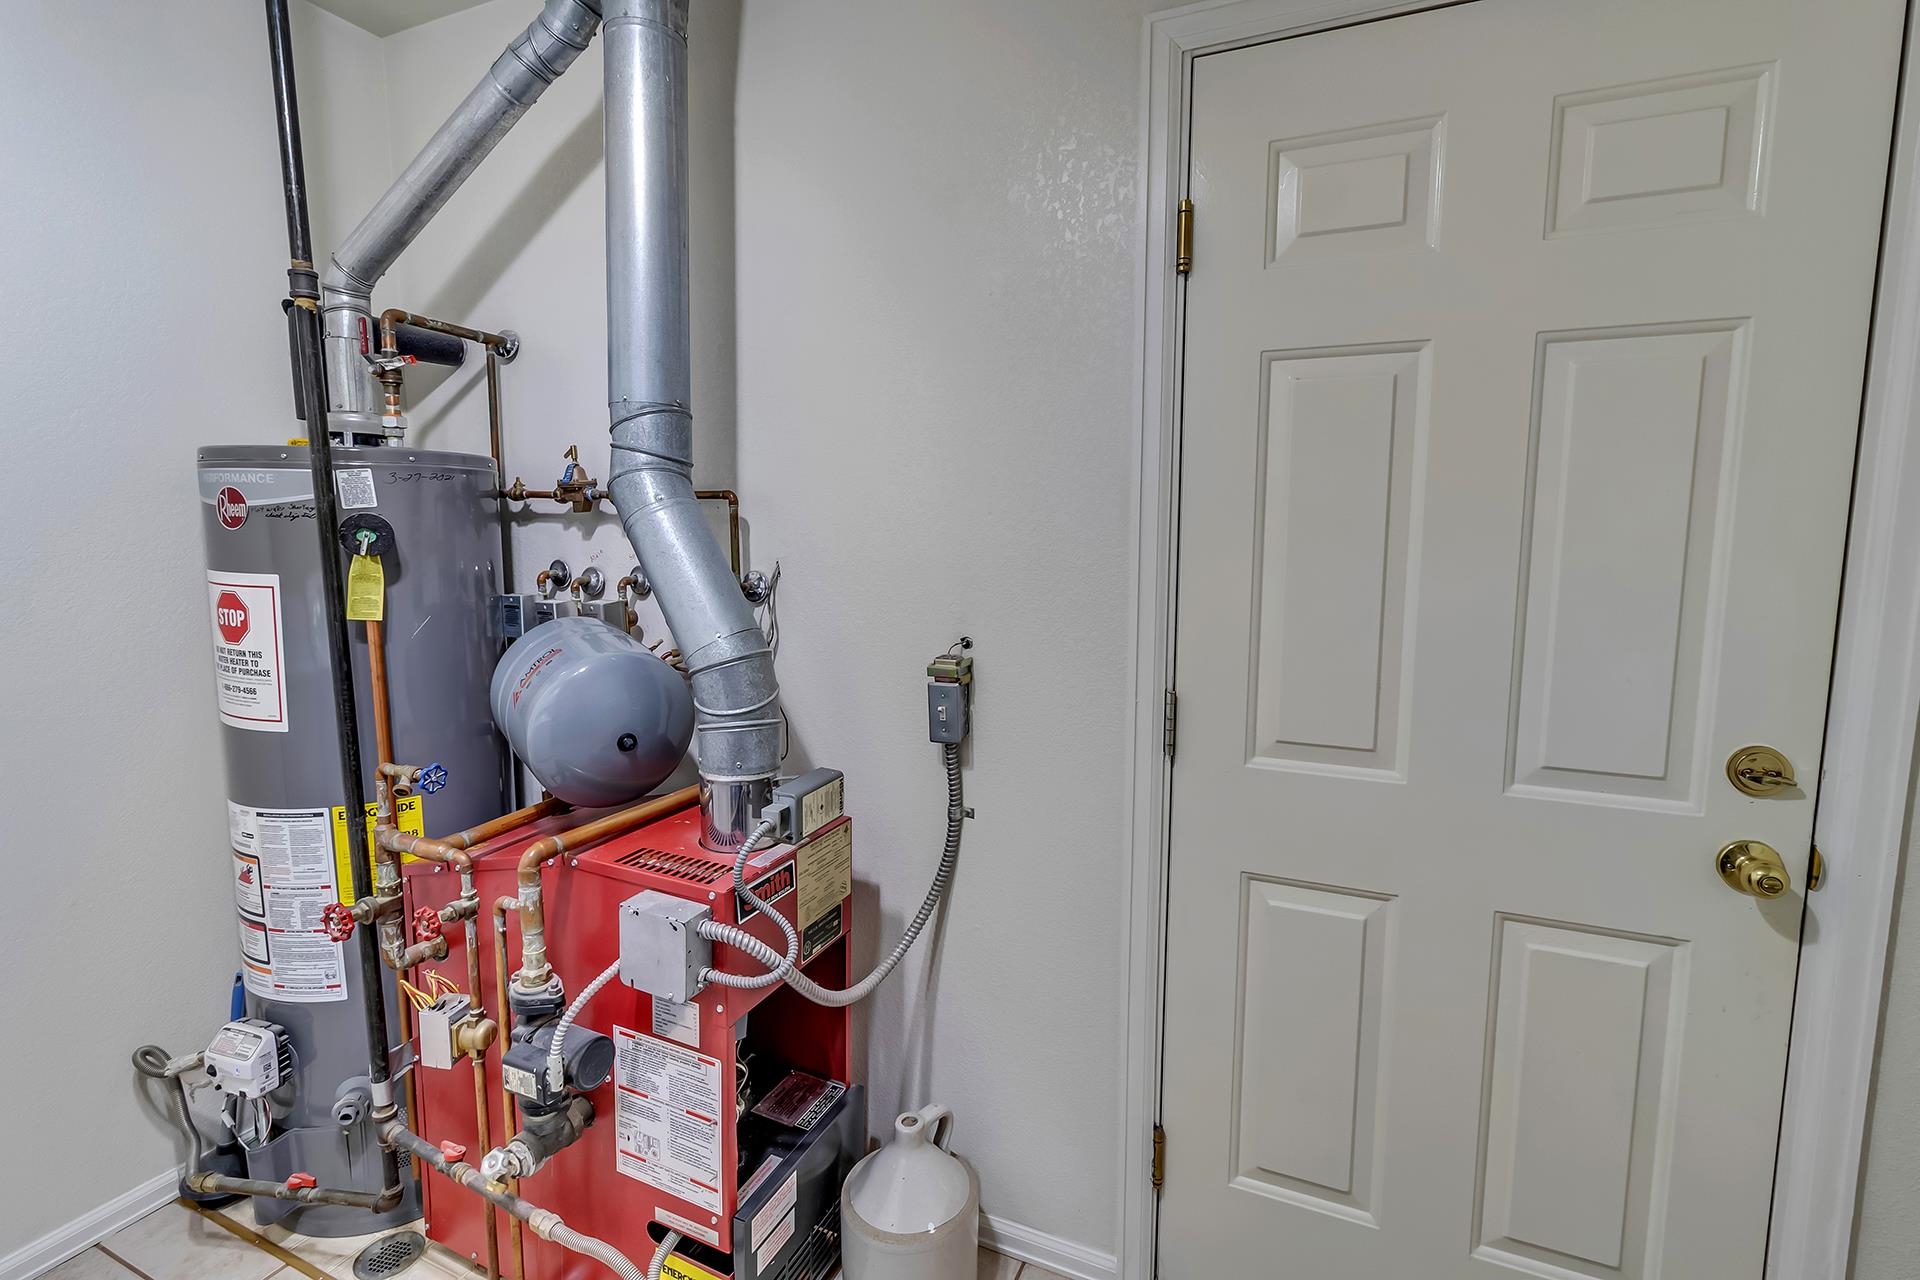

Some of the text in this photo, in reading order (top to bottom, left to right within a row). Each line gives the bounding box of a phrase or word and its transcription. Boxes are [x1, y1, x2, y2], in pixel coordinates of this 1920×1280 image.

[219, 486, 246, 523] Rheem
[218, 607, 245, 627] STOP
[227, 648, 246, 657] RETURN
[248, 650, 262, 659] THIS
[230, 658, 248, 667] HEATER
[520, 648, 555, 685] AMTROL
[239, 668, 271, 677] PURCHASE
[662, 1264, 696, 1280] ENERG
